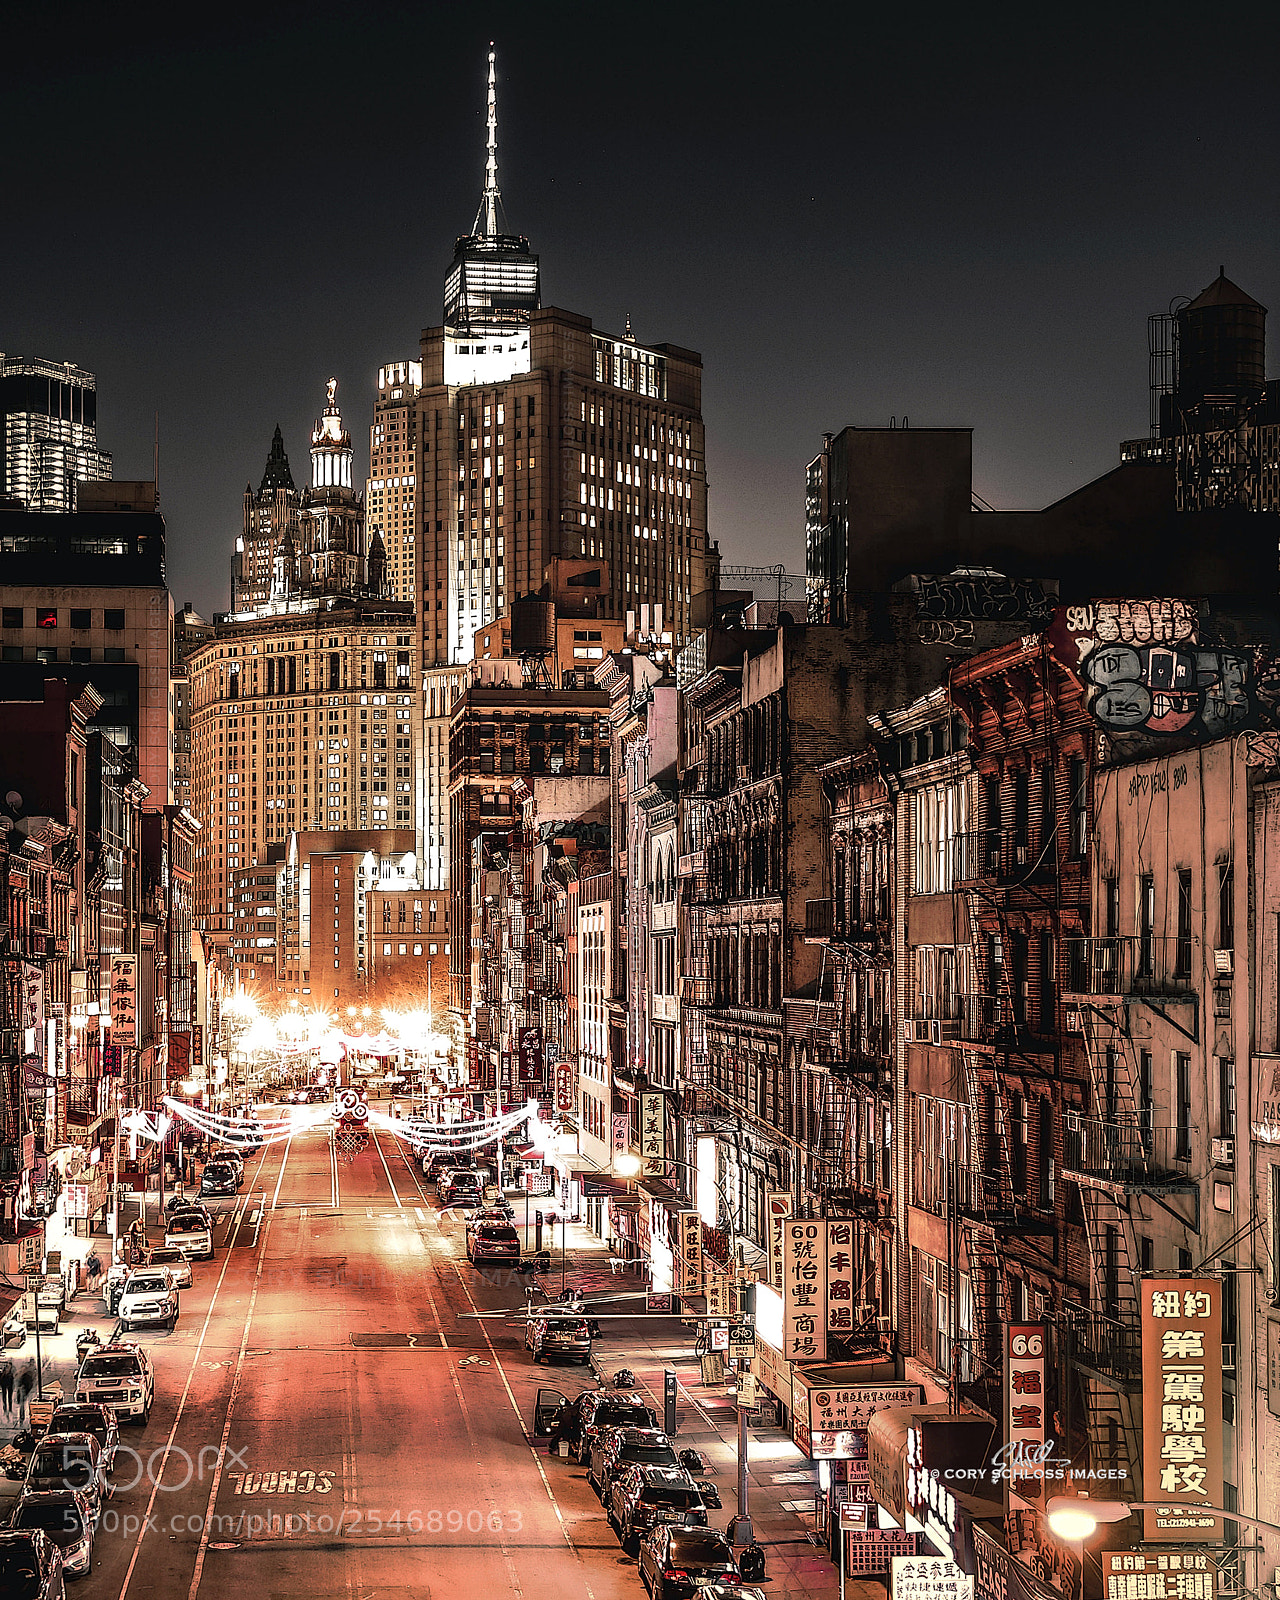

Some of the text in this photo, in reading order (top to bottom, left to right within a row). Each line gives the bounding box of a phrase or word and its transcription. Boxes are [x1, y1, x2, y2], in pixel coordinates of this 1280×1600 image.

[1151, 1290, 1212, 1318] 紐約
[1011, 1334, 1043, 1356] 66
[1160, 1330, 1208, 1496] 第一駕駛學校
[227, 1470, 336, 1495] SCHOOL
[977, 1556, 1008, 1600] LEASE
[1030, 1555, 1045, 1581] 66
